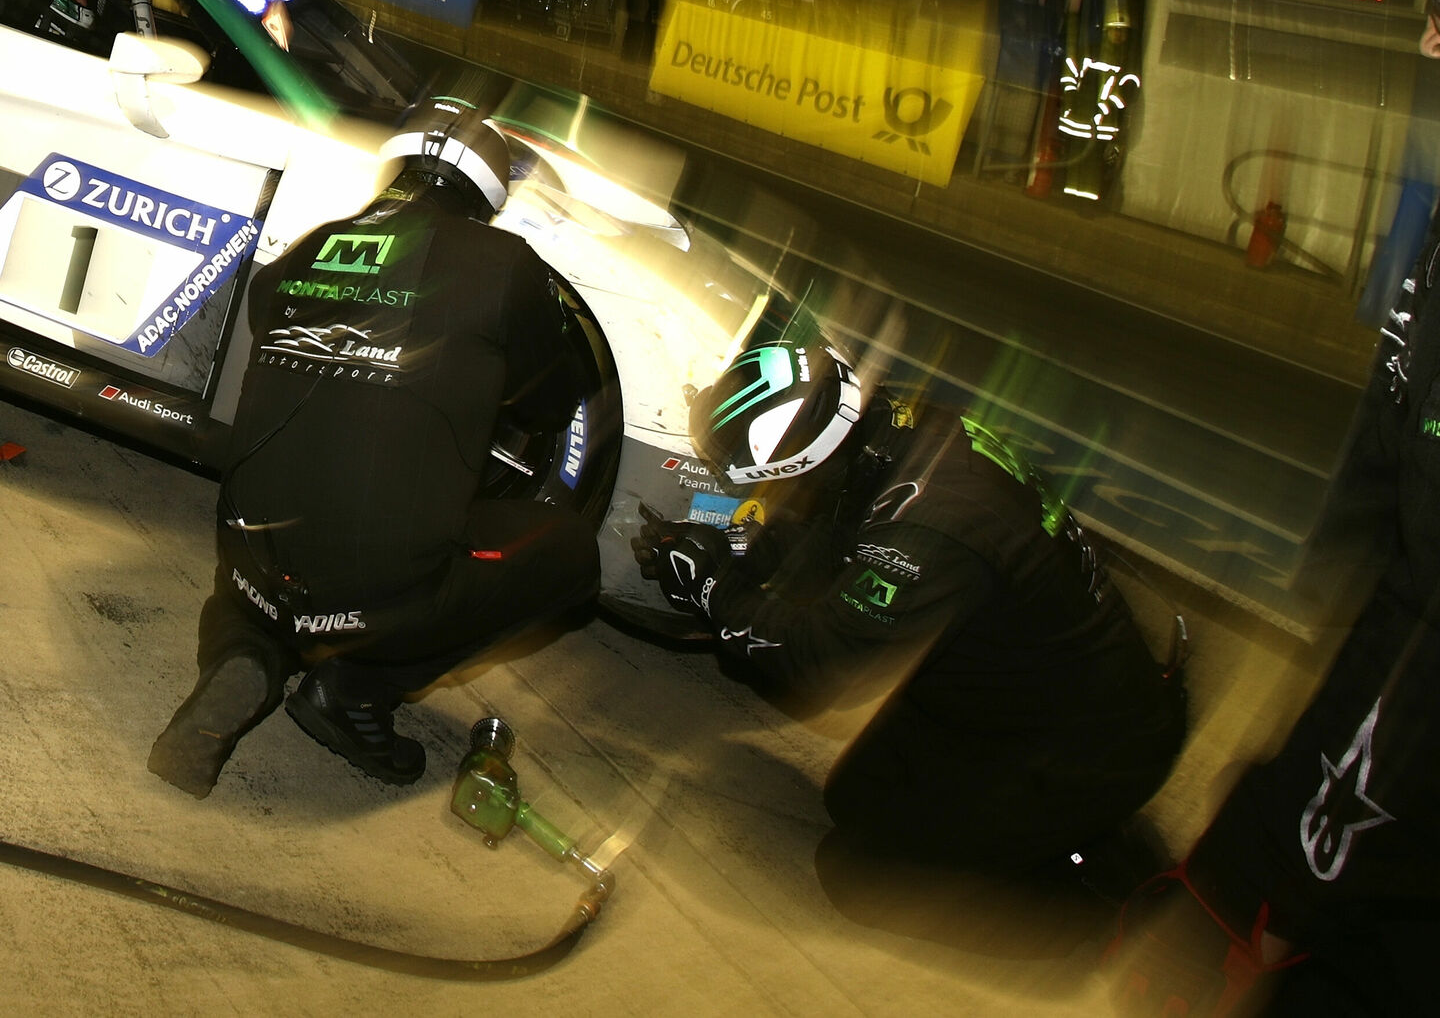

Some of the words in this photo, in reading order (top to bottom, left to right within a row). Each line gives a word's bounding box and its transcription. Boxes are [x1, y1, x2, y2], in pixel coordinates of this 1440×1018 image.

[671, 40, 791, 101] Deutsche
[796, 77, 866, 123] Post
[81, 178, 216, 246] ZURICH
[58, 225, 99, 315] 1
[137, 303, 181, 353] ADAC
[173, 219, 259, 312] NORDRHEIN
[276, 279, 414, 307] MONTAPLAST
[284, 305, 296, 319] by
[339, 339, 402, 362] Land
[22, 354, 75, 386] Castrol
[118, 391, 150, 411] Audi
[153, 403, 193, 424] Sport
[745, 456, 815, 480] uvex
[678, 474, 711, 491] Team
[689, 508, 732, 527] BILSTEIN
[891, 556, 920, 573] Land
